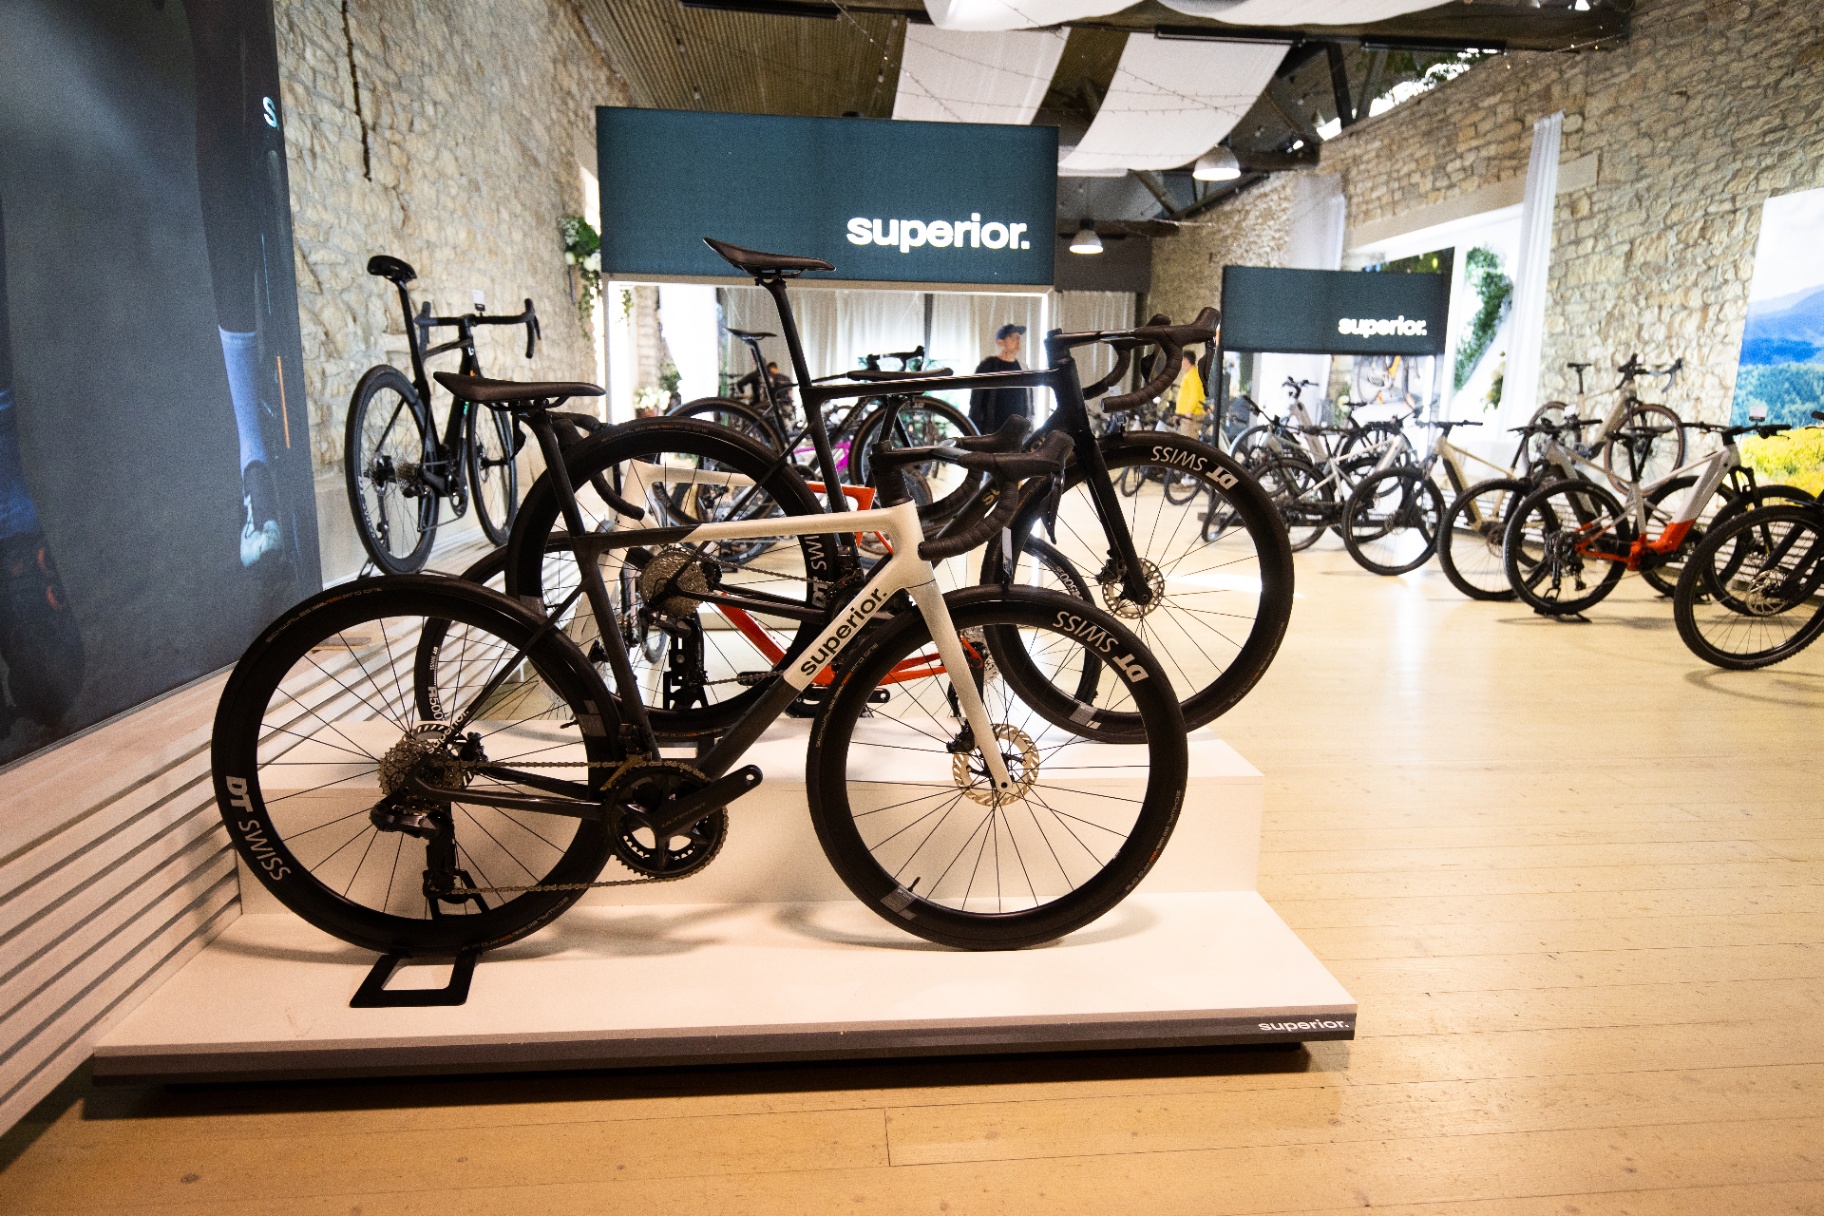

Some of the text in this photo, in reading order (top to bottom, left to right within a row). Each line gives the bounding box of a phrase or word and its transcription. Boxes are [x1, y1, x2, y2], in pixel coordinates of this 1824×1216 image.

[846, 212, 1031, 254] superior.
[1338, 315, 1428, 339] superior.
[1151, 445, 1239, 490] DT SWISS
[800, 588, 888, 676] superior.
[1052, 611, 1149, 682] DT SWISS
[428, 686, 444, 720] R500
[226, 775, 292, 880] DT SWISS
[1258, 1018, 1350, 1033] superior.
